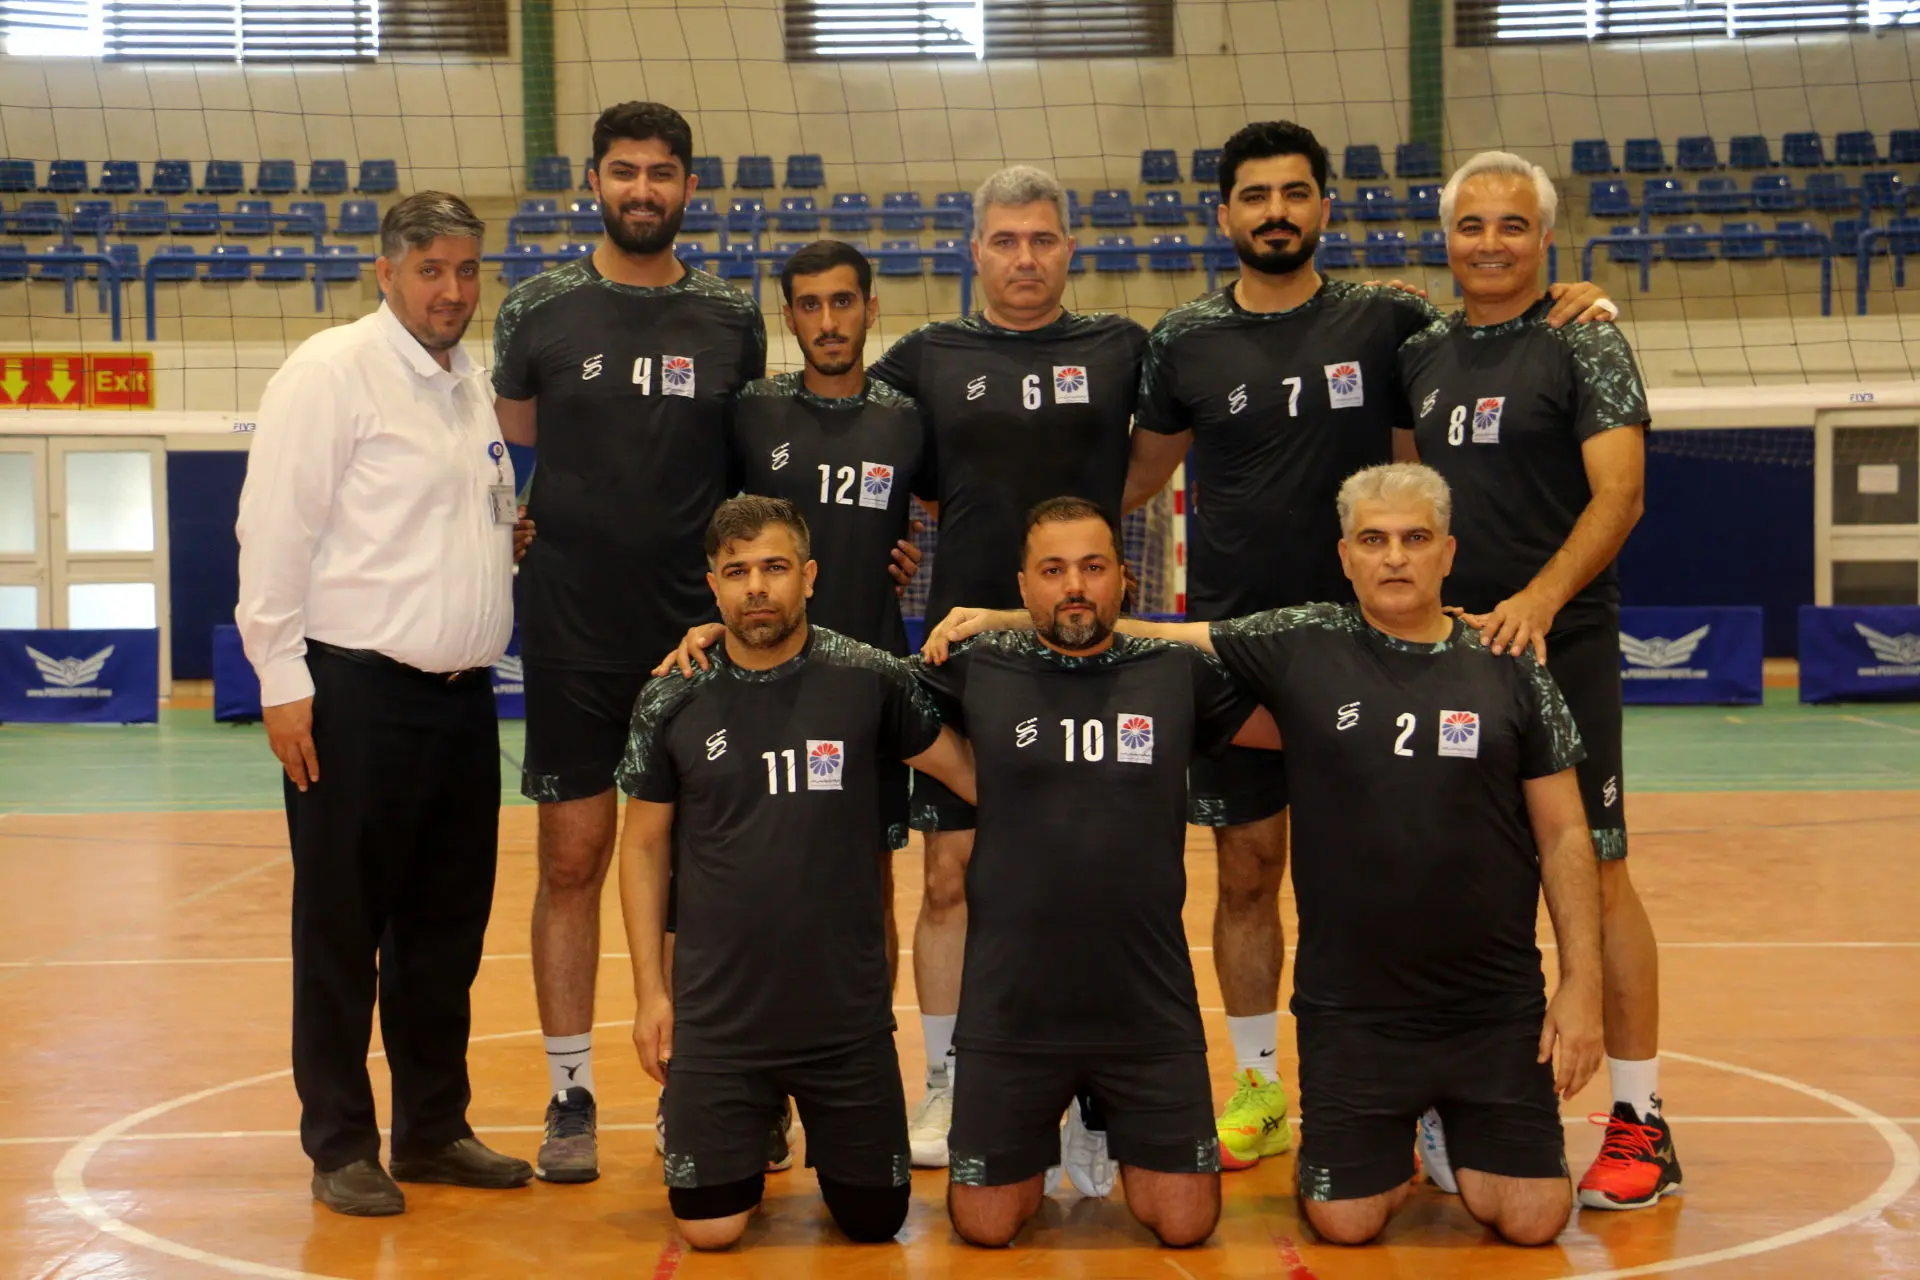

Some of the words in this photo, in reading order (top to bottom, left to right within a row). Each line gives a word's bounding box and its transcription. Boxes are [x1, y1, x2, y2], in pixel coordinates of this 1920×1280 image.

[96, 370, 147, 392] Exit
[632, 357, 652, 396] 4
[1022, 374, 1041, 410] 6
[1282, 376, 1302, 417] 7
[1447, 405, 1467, 446] 8
[818, 463, 856, 505] 12
[1060, 718, 1104, 762] 10
[1394, 712, 1416, 756] 2
[761, 749, 796, 795] 11
